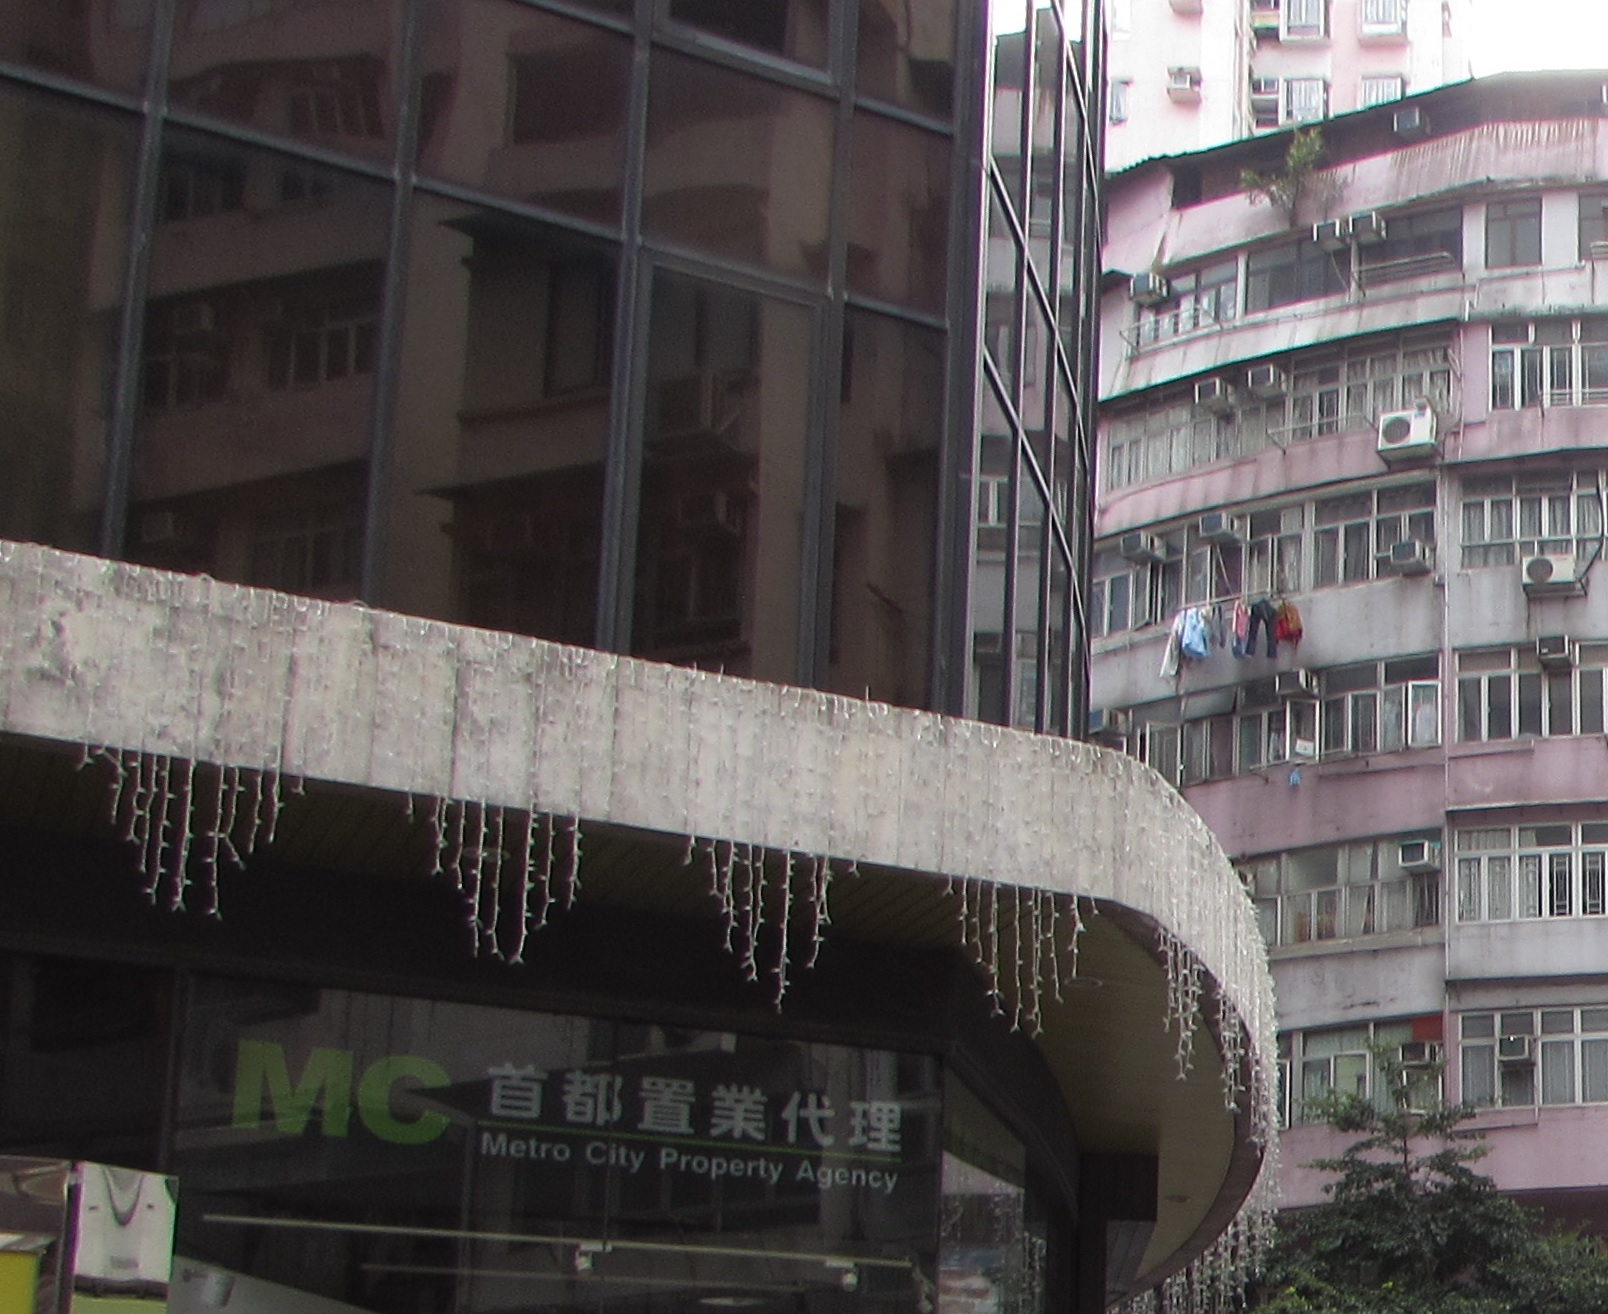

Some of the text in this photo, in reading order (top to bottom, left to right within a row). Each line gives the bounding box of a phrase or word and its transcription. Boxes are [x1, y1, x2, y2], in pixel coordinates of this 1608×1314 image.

[231, 1039, 454, 1146] MC
[486, 1063, 903, 1153] 首都置業代理
[480, 1131, 899, 1194] Metro City Property Agency
